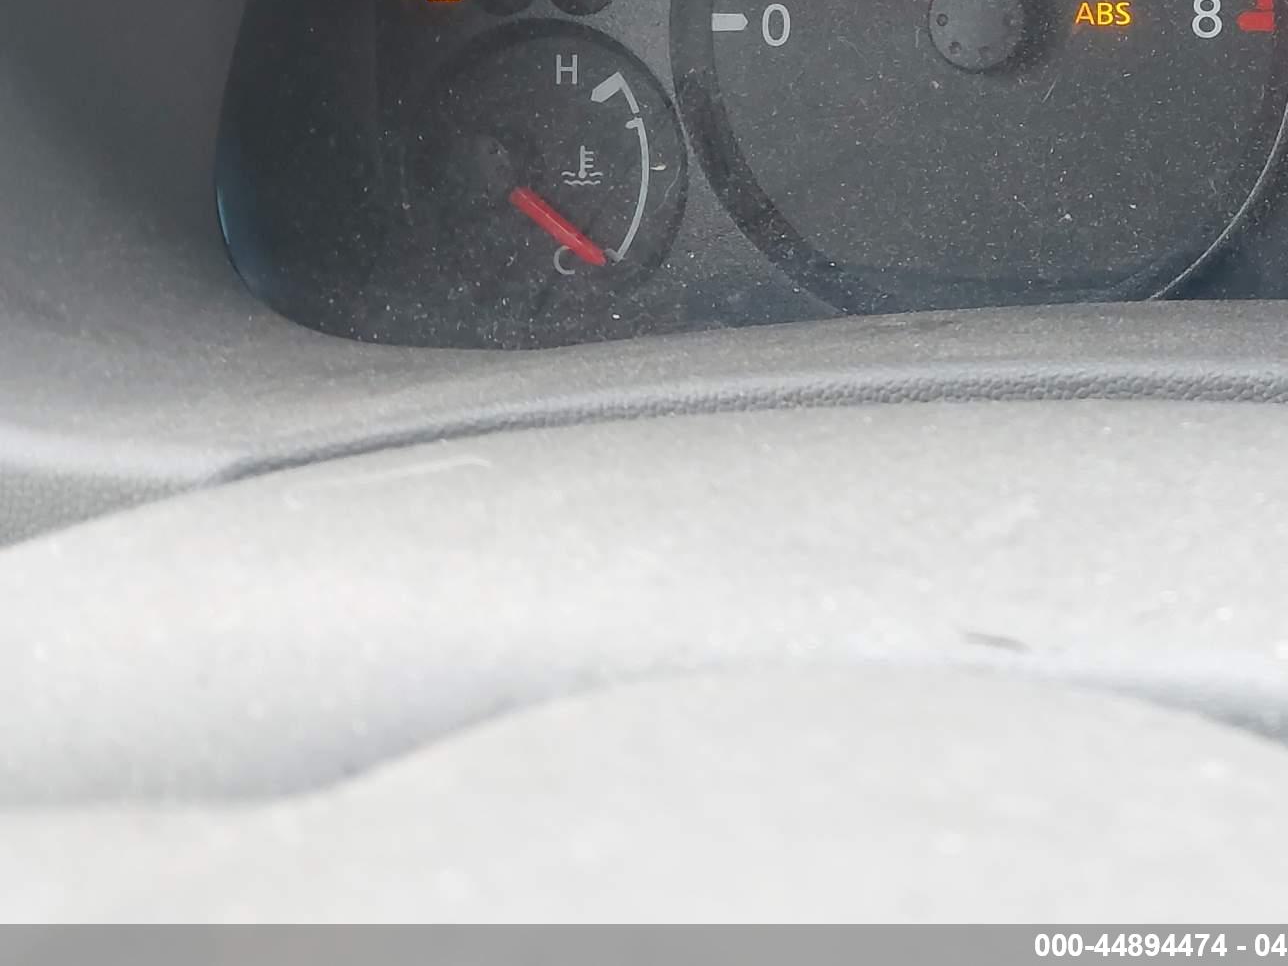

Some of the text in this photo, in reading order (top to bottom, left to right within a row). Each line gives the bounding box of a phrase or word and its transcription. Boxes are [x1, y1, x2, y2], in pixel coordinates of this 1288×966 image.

[762, 3, 791, 47] 0
[1075, 1, 1131, 26] ABS
[556, 54, 578, 85] H
